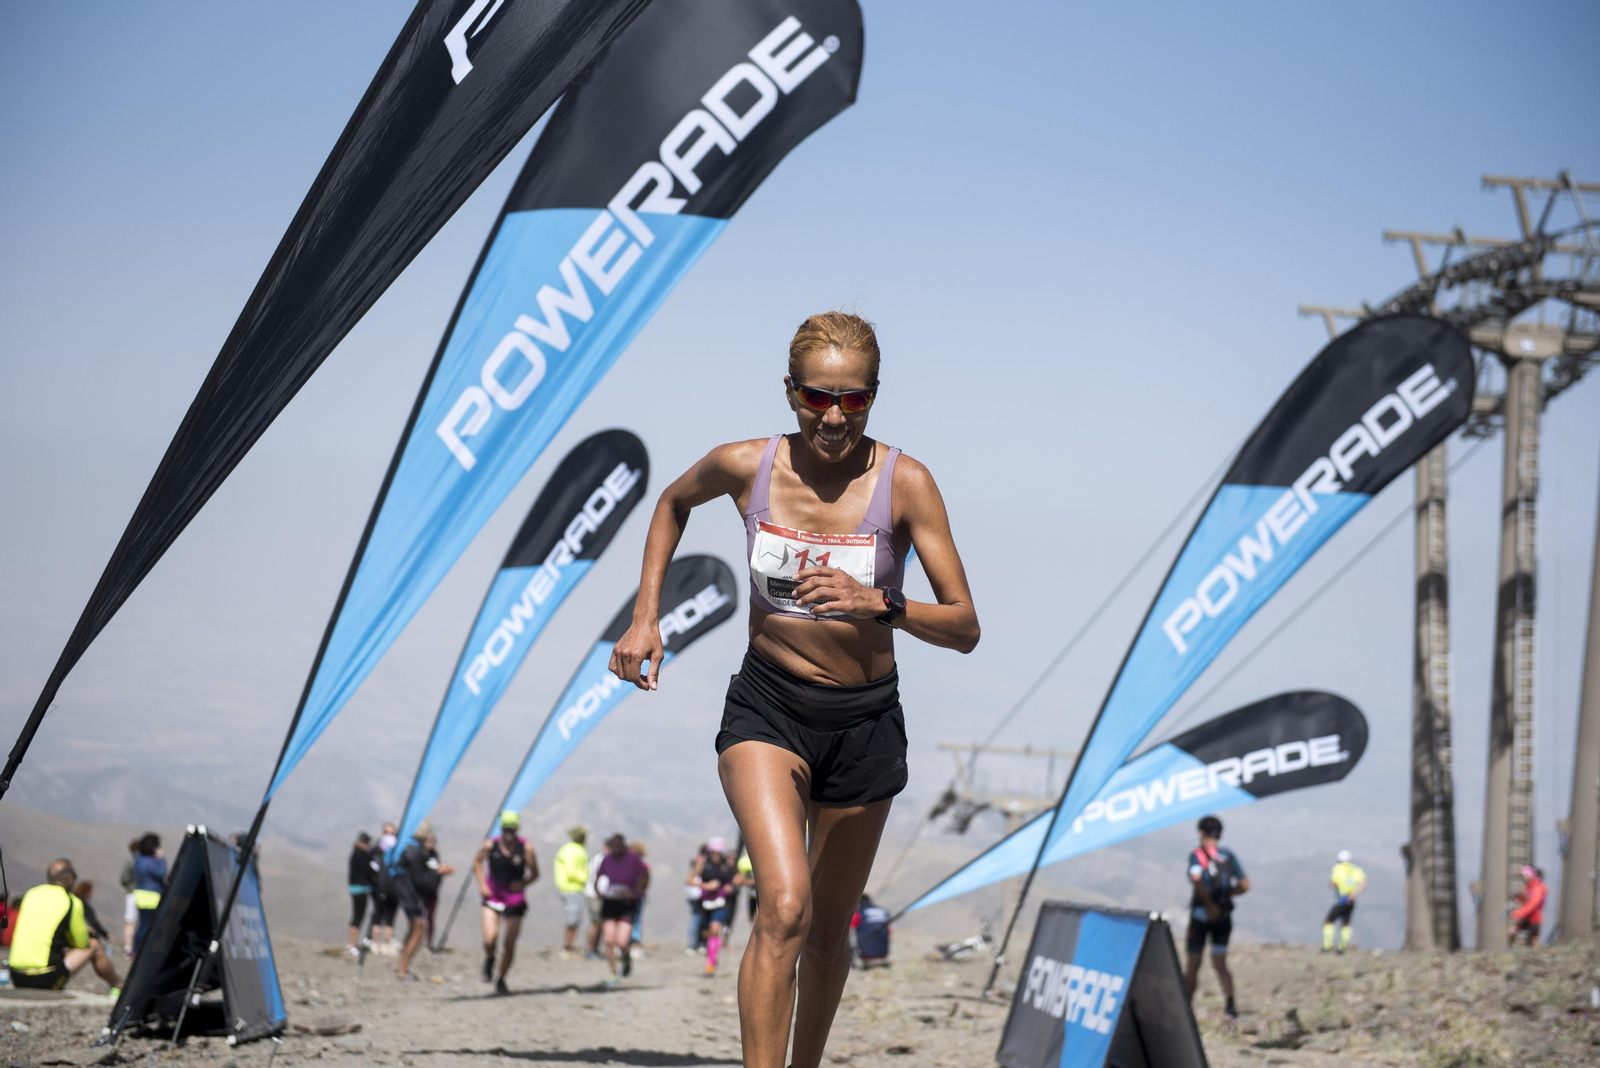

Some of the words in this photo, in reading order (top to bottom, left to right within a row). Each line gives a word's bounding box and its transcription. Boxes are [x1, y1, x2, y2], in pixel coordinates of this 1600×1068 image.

[437, 15, 829, 470] POWERADE
[795, 549, 831, 571] 11
[801, 535, 824, 543] RUNNING
[1163, 362, 1450, 655] POWERADE
[463, 462, 636, 696] POWERADE
[556, 584, 730, 740] POWADE
[1072, 734, 1344, 834] POWERADE
[1022, 955, 1125, 1035] POWERADE
